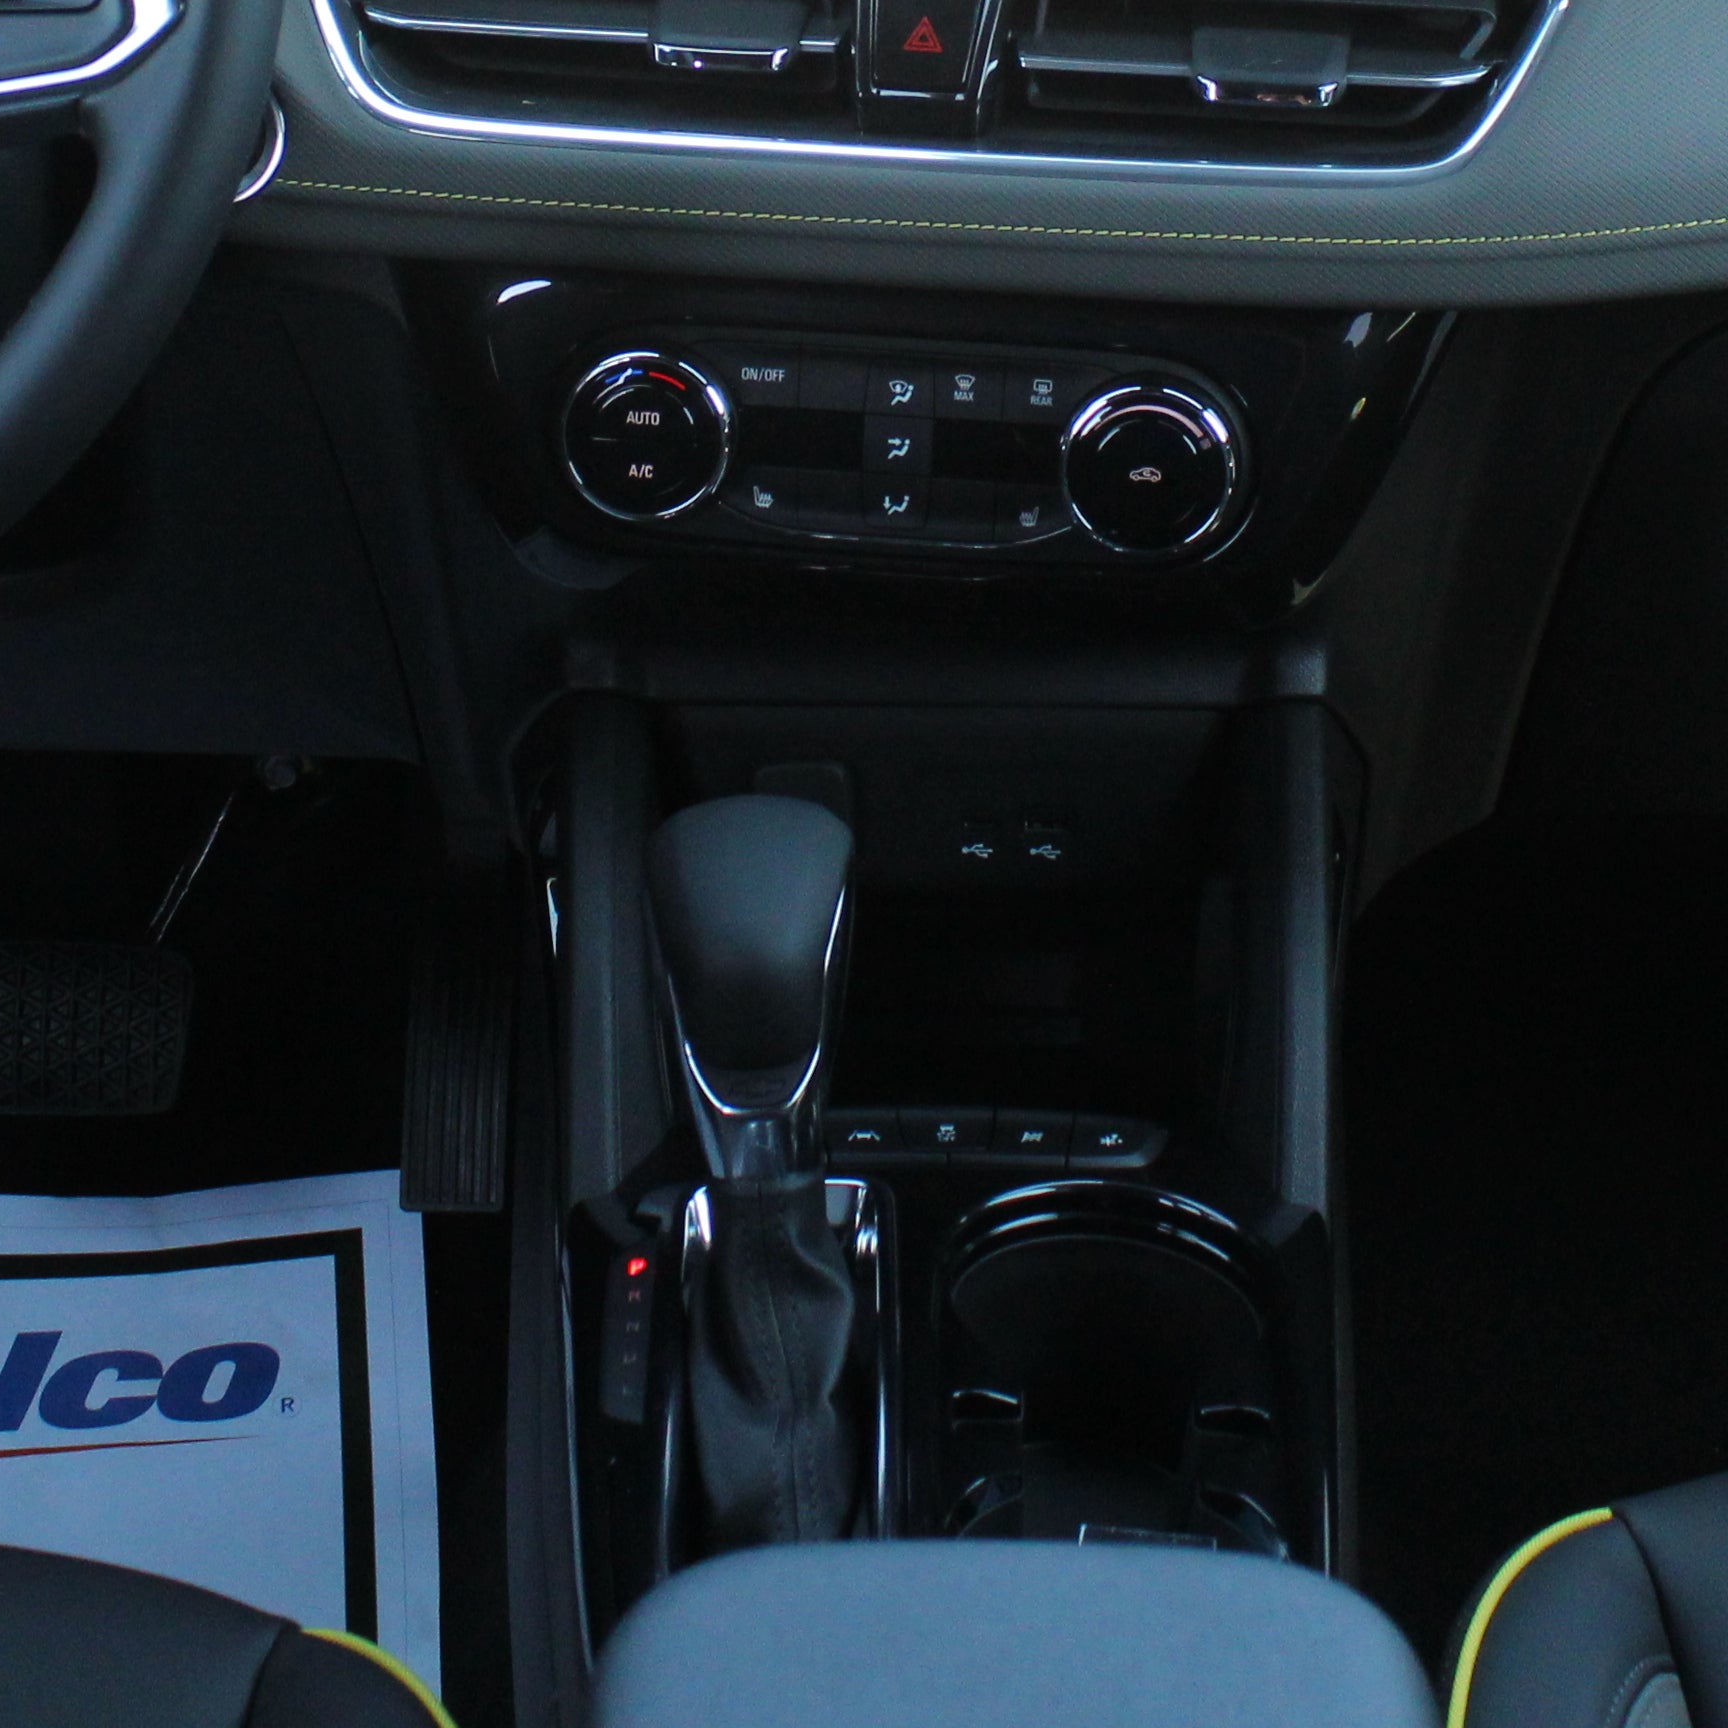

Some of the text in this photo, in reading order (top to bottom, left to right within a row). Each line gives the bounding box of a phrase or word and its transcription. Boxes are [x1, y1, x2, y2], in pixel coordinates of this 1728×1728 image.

[741, 367, 785, 382] ON/OFF
[953, 390, 974, 401] MAX
[1030, 395, 1052, 406] REAR
[626, 411, 660, 425] AUTO
[628, 464, 653, 478] A/C
